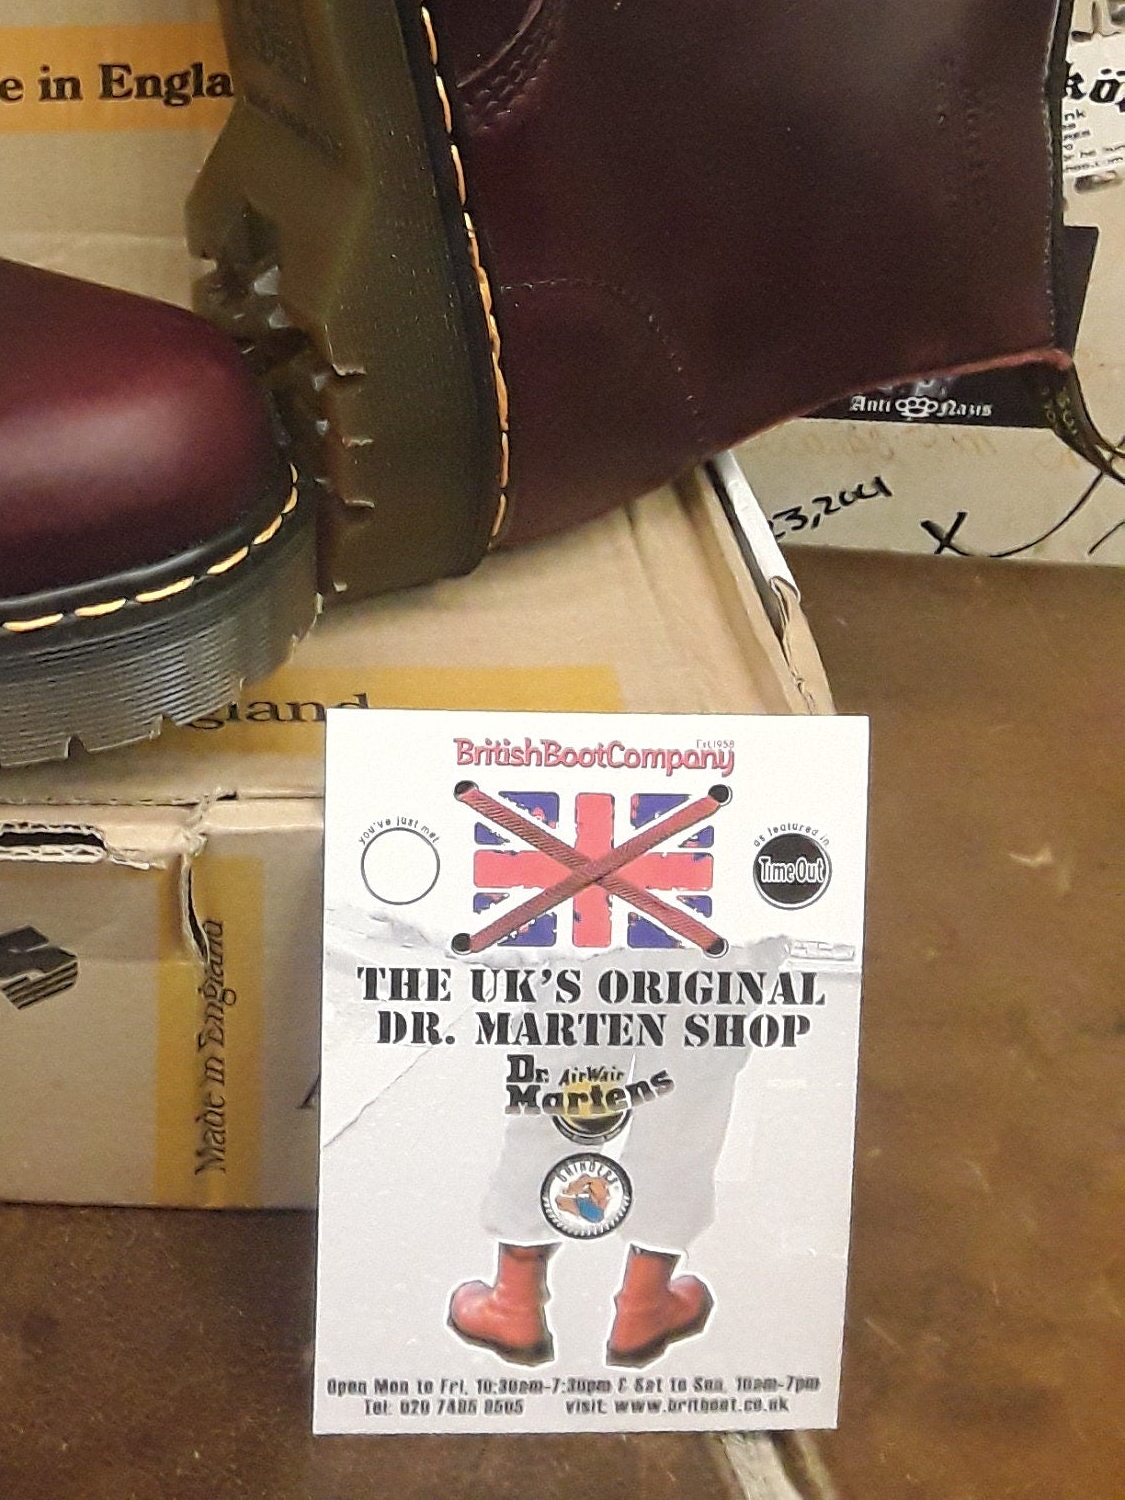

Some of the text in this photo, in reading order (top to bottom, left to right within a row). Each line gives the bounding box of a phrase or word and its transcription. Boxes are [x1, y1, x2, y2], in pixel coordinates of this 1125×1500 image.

[38, 64, 85, 102] in
[849, 395, 891, 414] Anti
[453, 736, 735, 778] BritishBootCompany
[356, 965, 826, 1007] THE UK'S ORIGINAL
[376, 1010, 811, 1049] DR. MARTEN SHOP
[506, 1053, 550, 1084] Dr.
[504, 1069, 676, 1116] Martens
[326, 1378, 368, 1398] Open
[374, 1378, 410, 1396] Mon
[633, 1377, 664, 1394] Sat
